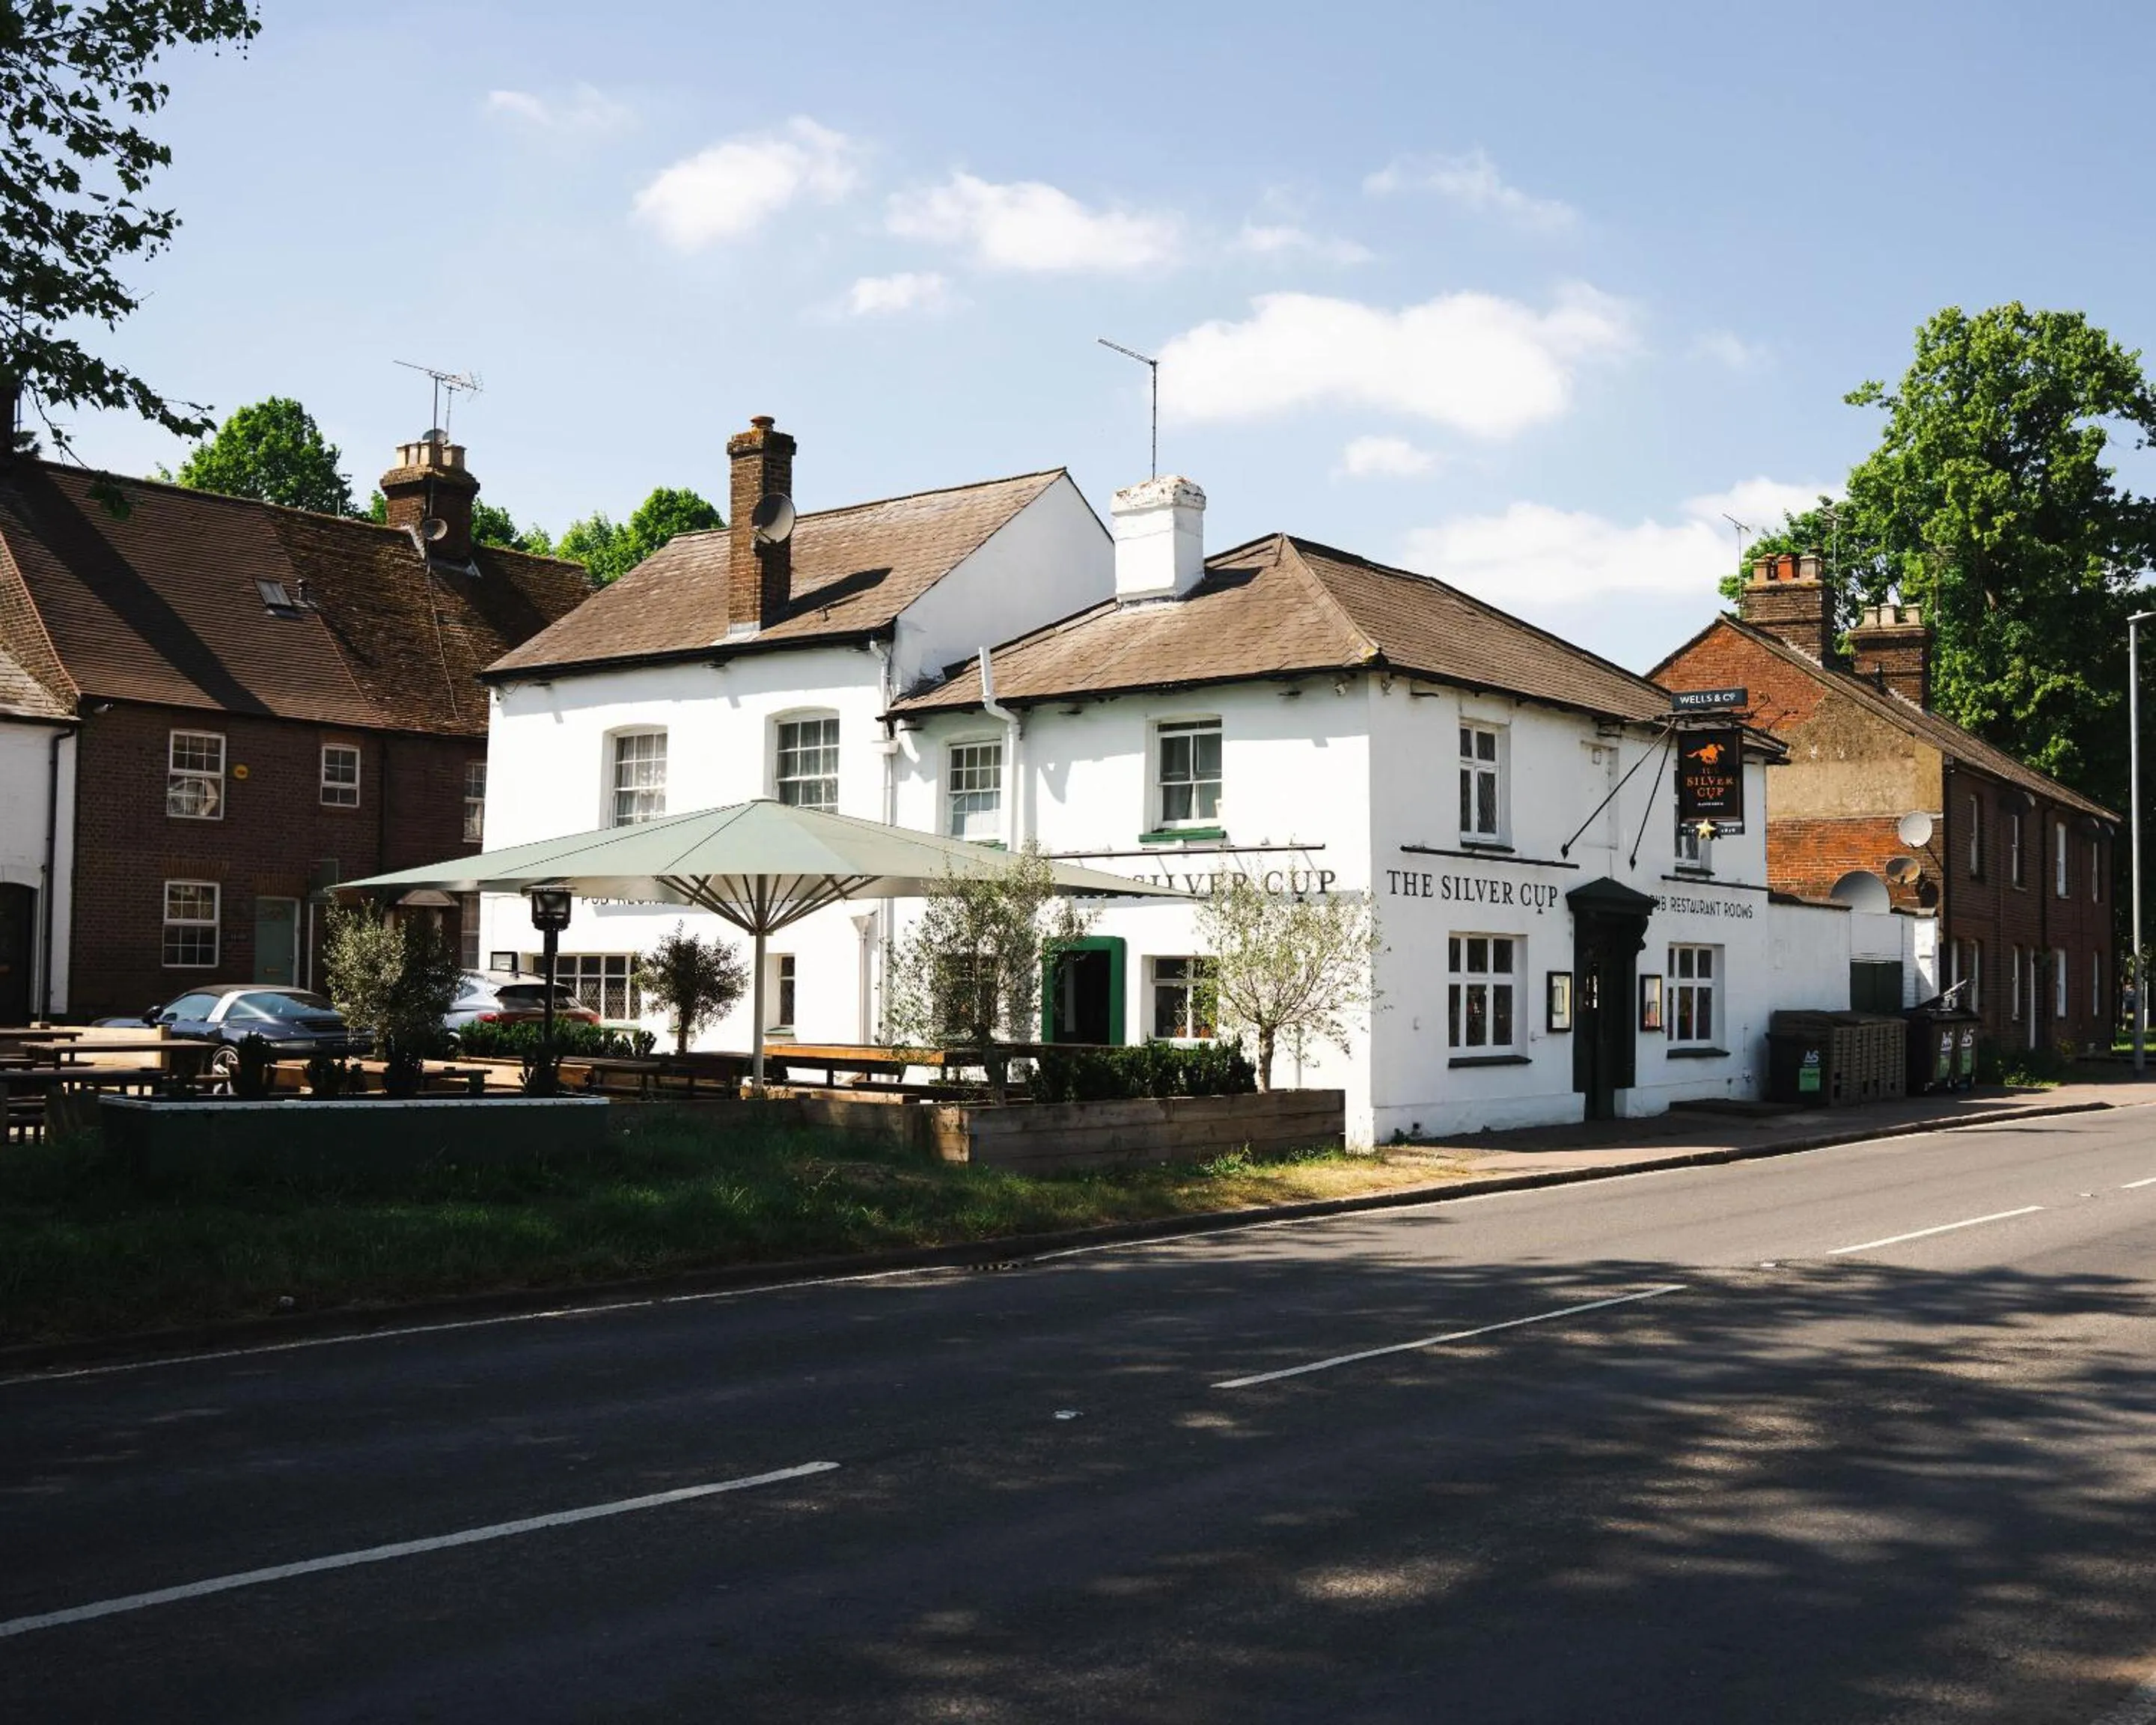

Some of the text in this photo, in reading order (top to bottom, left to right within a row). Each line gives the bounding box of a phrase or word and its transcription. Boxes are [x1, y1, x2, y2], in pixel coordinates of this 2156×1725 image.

[1679, 694, 1712, 704] WELLS
[1714, 694, 1721, 702] &
[1686, 776, 1734, 787] SILVER
[1697, 787, 1724, 799] CUP
[1264, 870, 1336, 902] CUP
[1387, 870, 1557, 914] THE SILVER CUP
[1670, 897, 1721, 917] RESTAURANT
[1724, 902, 1753, 919] ROOMS
